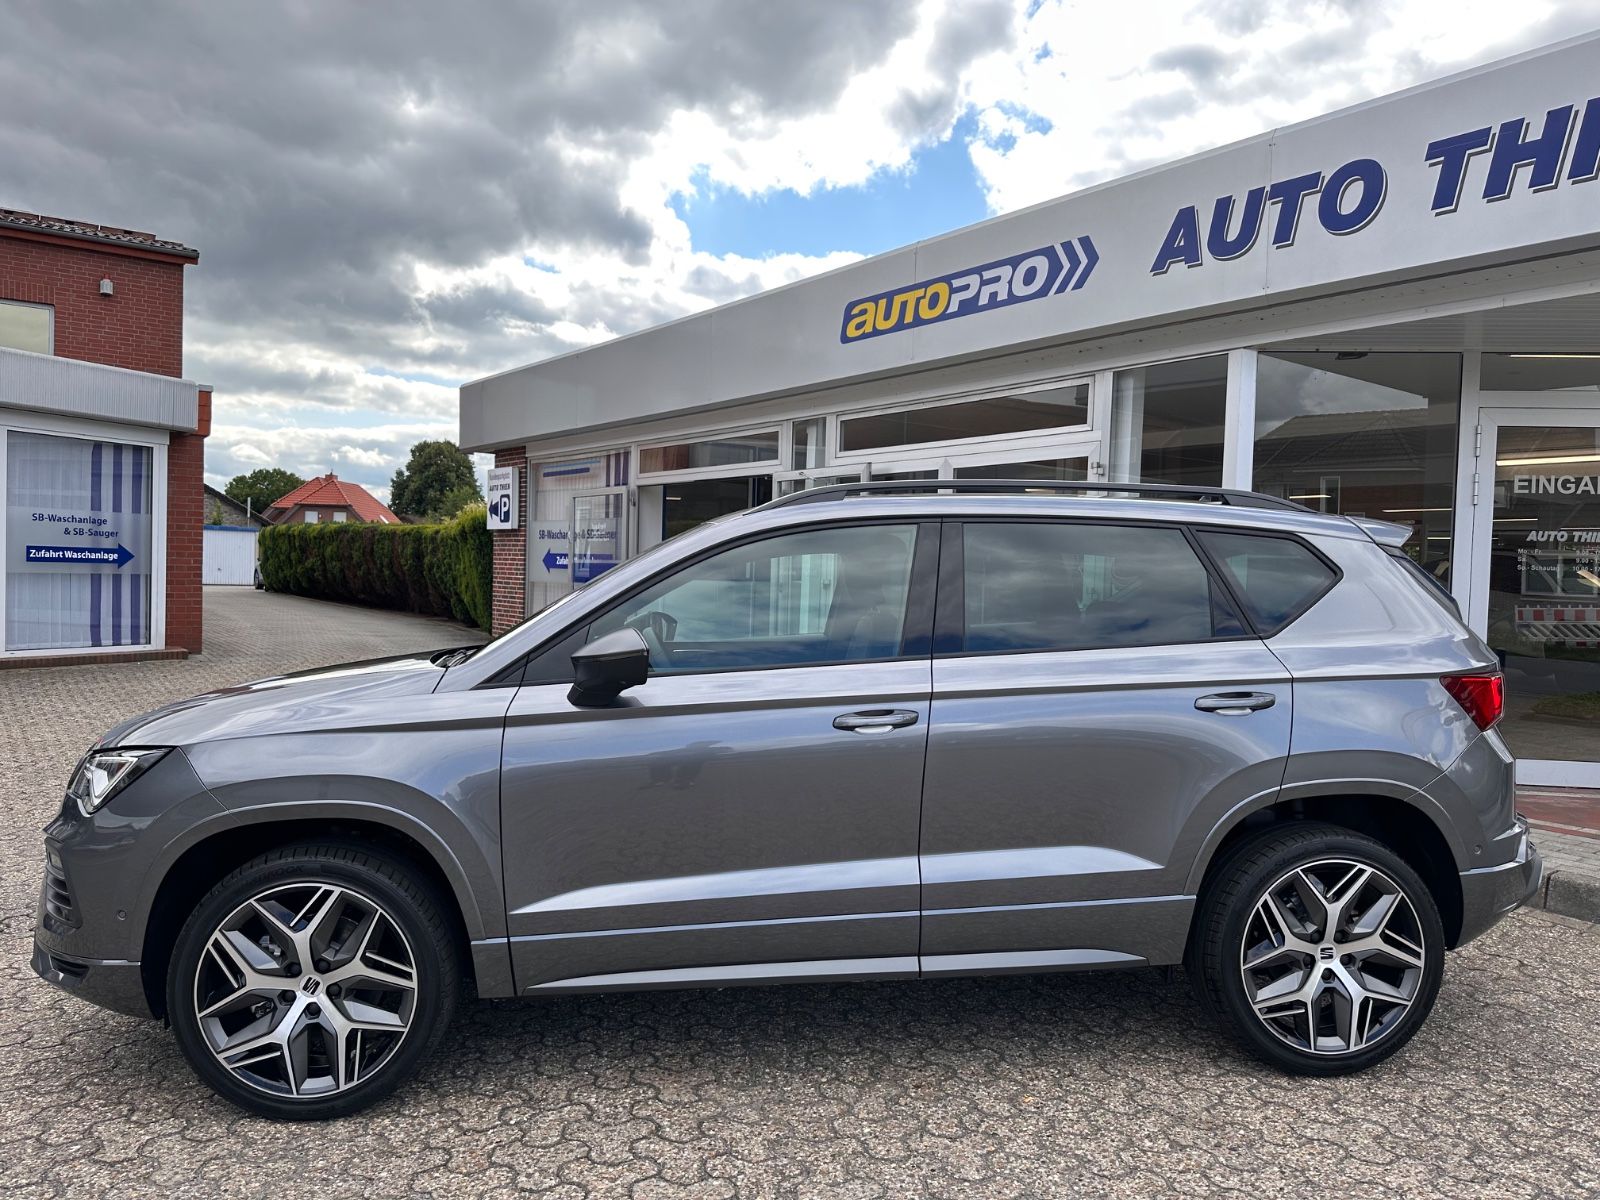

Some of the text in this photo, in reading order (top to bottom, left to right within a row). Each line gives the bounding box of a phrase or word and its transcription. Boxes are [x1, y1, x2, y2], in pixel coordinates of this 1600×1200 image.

[1150, 158, 1389, 276] AUTO
[1513, 475, 1600, 494] EINGA
[32, 513, 107, 526] SB-Waschanlage
[73, 528, 119, 539] SB-Sauger
[1526, 530, 1600, 543] AUTO THI
[29, 549, 119, 561] Zufahrt Waschanlage
